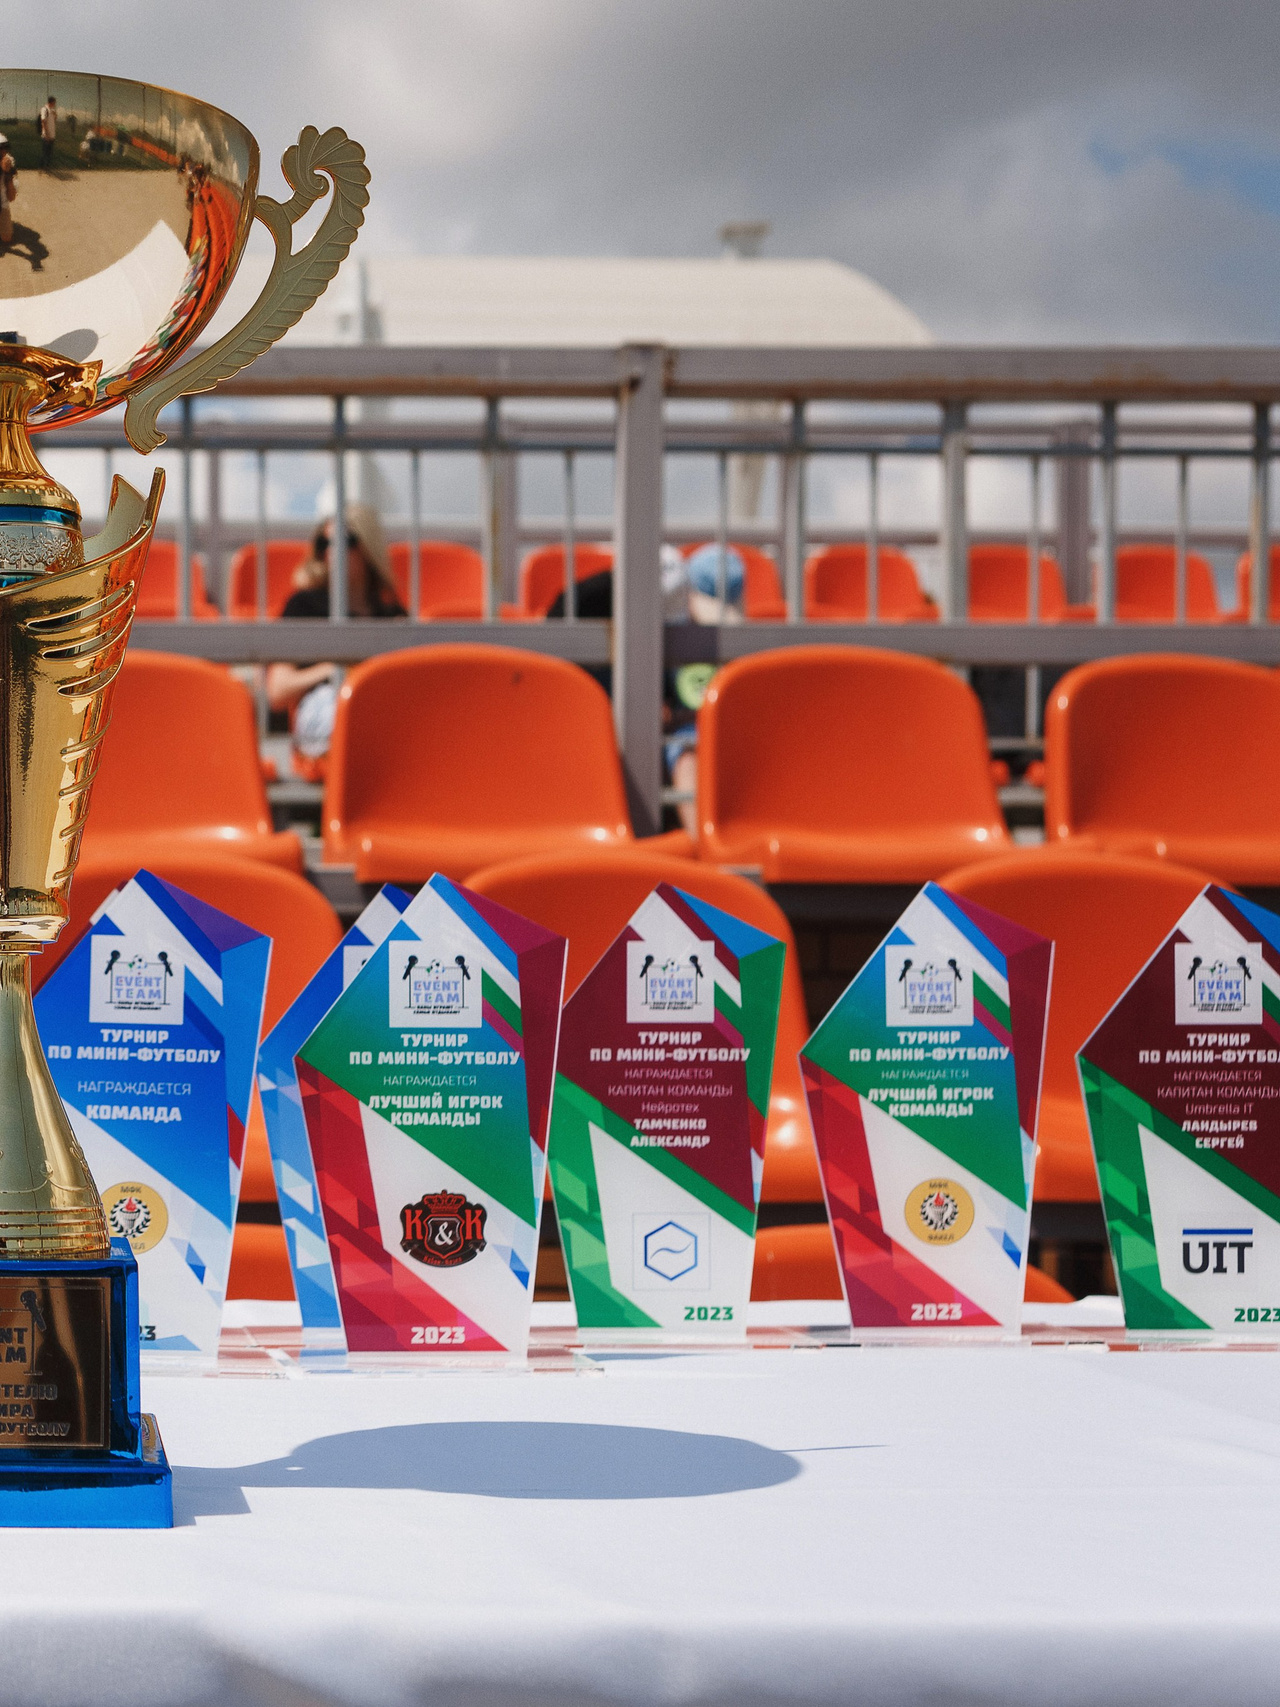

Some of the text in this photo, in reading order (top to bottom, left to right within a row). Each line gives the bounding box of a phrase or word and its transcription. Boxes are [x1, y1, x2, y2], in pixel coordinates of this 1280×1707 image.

[115, 976, 162, 988] EVENT
[413, 980, 460, 992] EVENT
[650, 978, 694, 989] EVENT
[909, 981, 952, 992] EVENT
[1198, 979, 1242, 990] EVENT
[115, 988, 162, 1000] TEAM
[413, 992, 460, 1004] TEAM
[650, 989, 694, 1000] TEAM
[910, 993, 953, 1003] TEAM
[1198, 991, 1242, 1001] TEAM
[100, 1029, 169, 1044] ТУРНИР
[400, 1033, 469, 1048] ТУРНИР
[638, 1031, 702, 1046] ТУРНИР
[897, 1031, 961, 1045] ТУРНИР
[1187, 1033, 1250, 1047] ТУРНИР
[48, 1045, 221, 1064] ПО МИНИ-ФУТБОЛУ
[349, 1050, 520, 1066] ПО МИНИ-ФУТБОЛУ
[590, 1047, 751, 1062] ПО МИНИ-ФУТБОЛУ
[849, 1046, 1009, 1062] ПО МИНИ-ФУТБОЛУ
[1139, 1050, 1161, 1063] ПО
[383, 1075, 477, 1087] НАГРАЖДАЕТСЯ
[624, 1068, 713, 1080] НАГРАЖДАЕТСЯ
[881, 1068, 969, 1081] НАГРАЖДАЕТСЯ
[1173, 1070, 1262, 1083] НАГРАЖДАЕТСЯ
[77, 1081, 192, 1096] НАГРАЖДАЕТСЯ
[608, 1085, 733, 1098] КАПИТАН КОМАНДЫ
[868, 1084, 994, 1101] ЛУЧШИЙ ИГРОК
[1157, 1086, 1280, 1100] КАПИТАН КОМАНДЫ
[370, 1092, 503, 1109] ЛУЧШИЙ ИГРОК
[86, 1104, 182, 1124] КОМАНДА
[641, 1101, 699, 1115] Нейротех
[889, 1102, 973, 1118] КОМАНДЫ
[1185, 1102, 1254, 1115] Umbrella IT
[391, 1112, 480, 1127] КОМАНДЫ
[634, 1118, 707, 1131] ТАМЧЕНКО
[1181, 1119, 1258, 1133] ЛАНДЫРЕВ
[630, 1135, 711, 1149] АЛЕКСАНДР
[1195, 1135, 1244, 1149] СЕРГЕЙ
[1183, 1241, 1253, 1274] UIT
[683, 1306, 733, 1321] 2023
[911, 1303, 962, 1321] 2023
[1234, 1307, 1280, 1323] 2023
[411, 1326, 466, 1344] 2023
